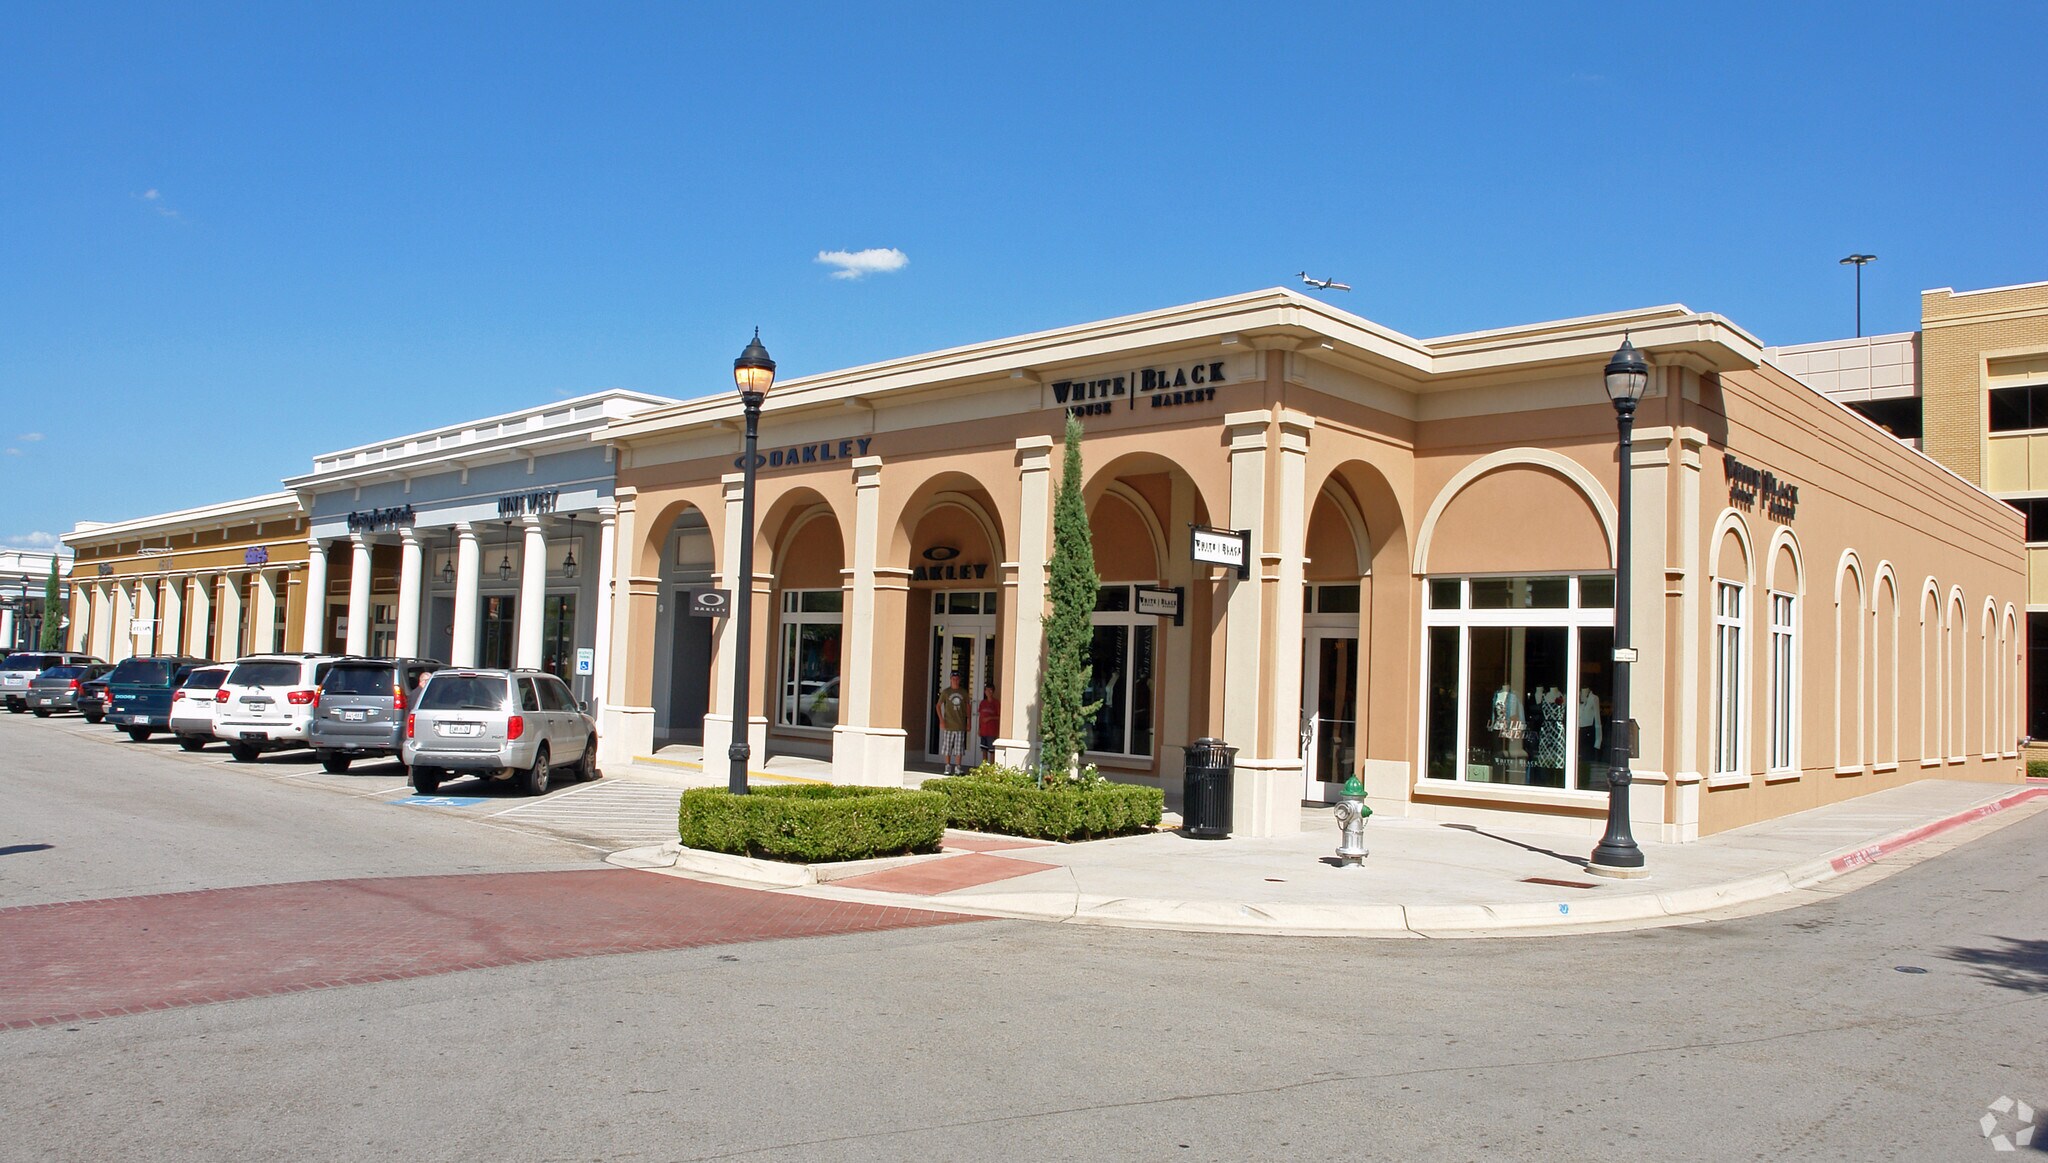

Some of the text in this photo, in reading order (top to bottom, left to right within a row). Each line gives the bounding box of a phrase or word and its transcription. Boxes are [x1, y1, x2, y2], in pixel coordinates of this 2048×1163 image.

[1052, 361, 1225, 403] WHITE BLACK
[1151, 387, 1216, 408] MARKET
[769, 437, 872, 467] OAKLEY
[1195, 539, 1216, 551] WHITE
[1222, 543, 1241, 555] BLACK
[912, 564, 988, 580] AKLEY
[1139, 596, 1157, 605] WHITE
[1161, 598, 1177, 606] BLACK
